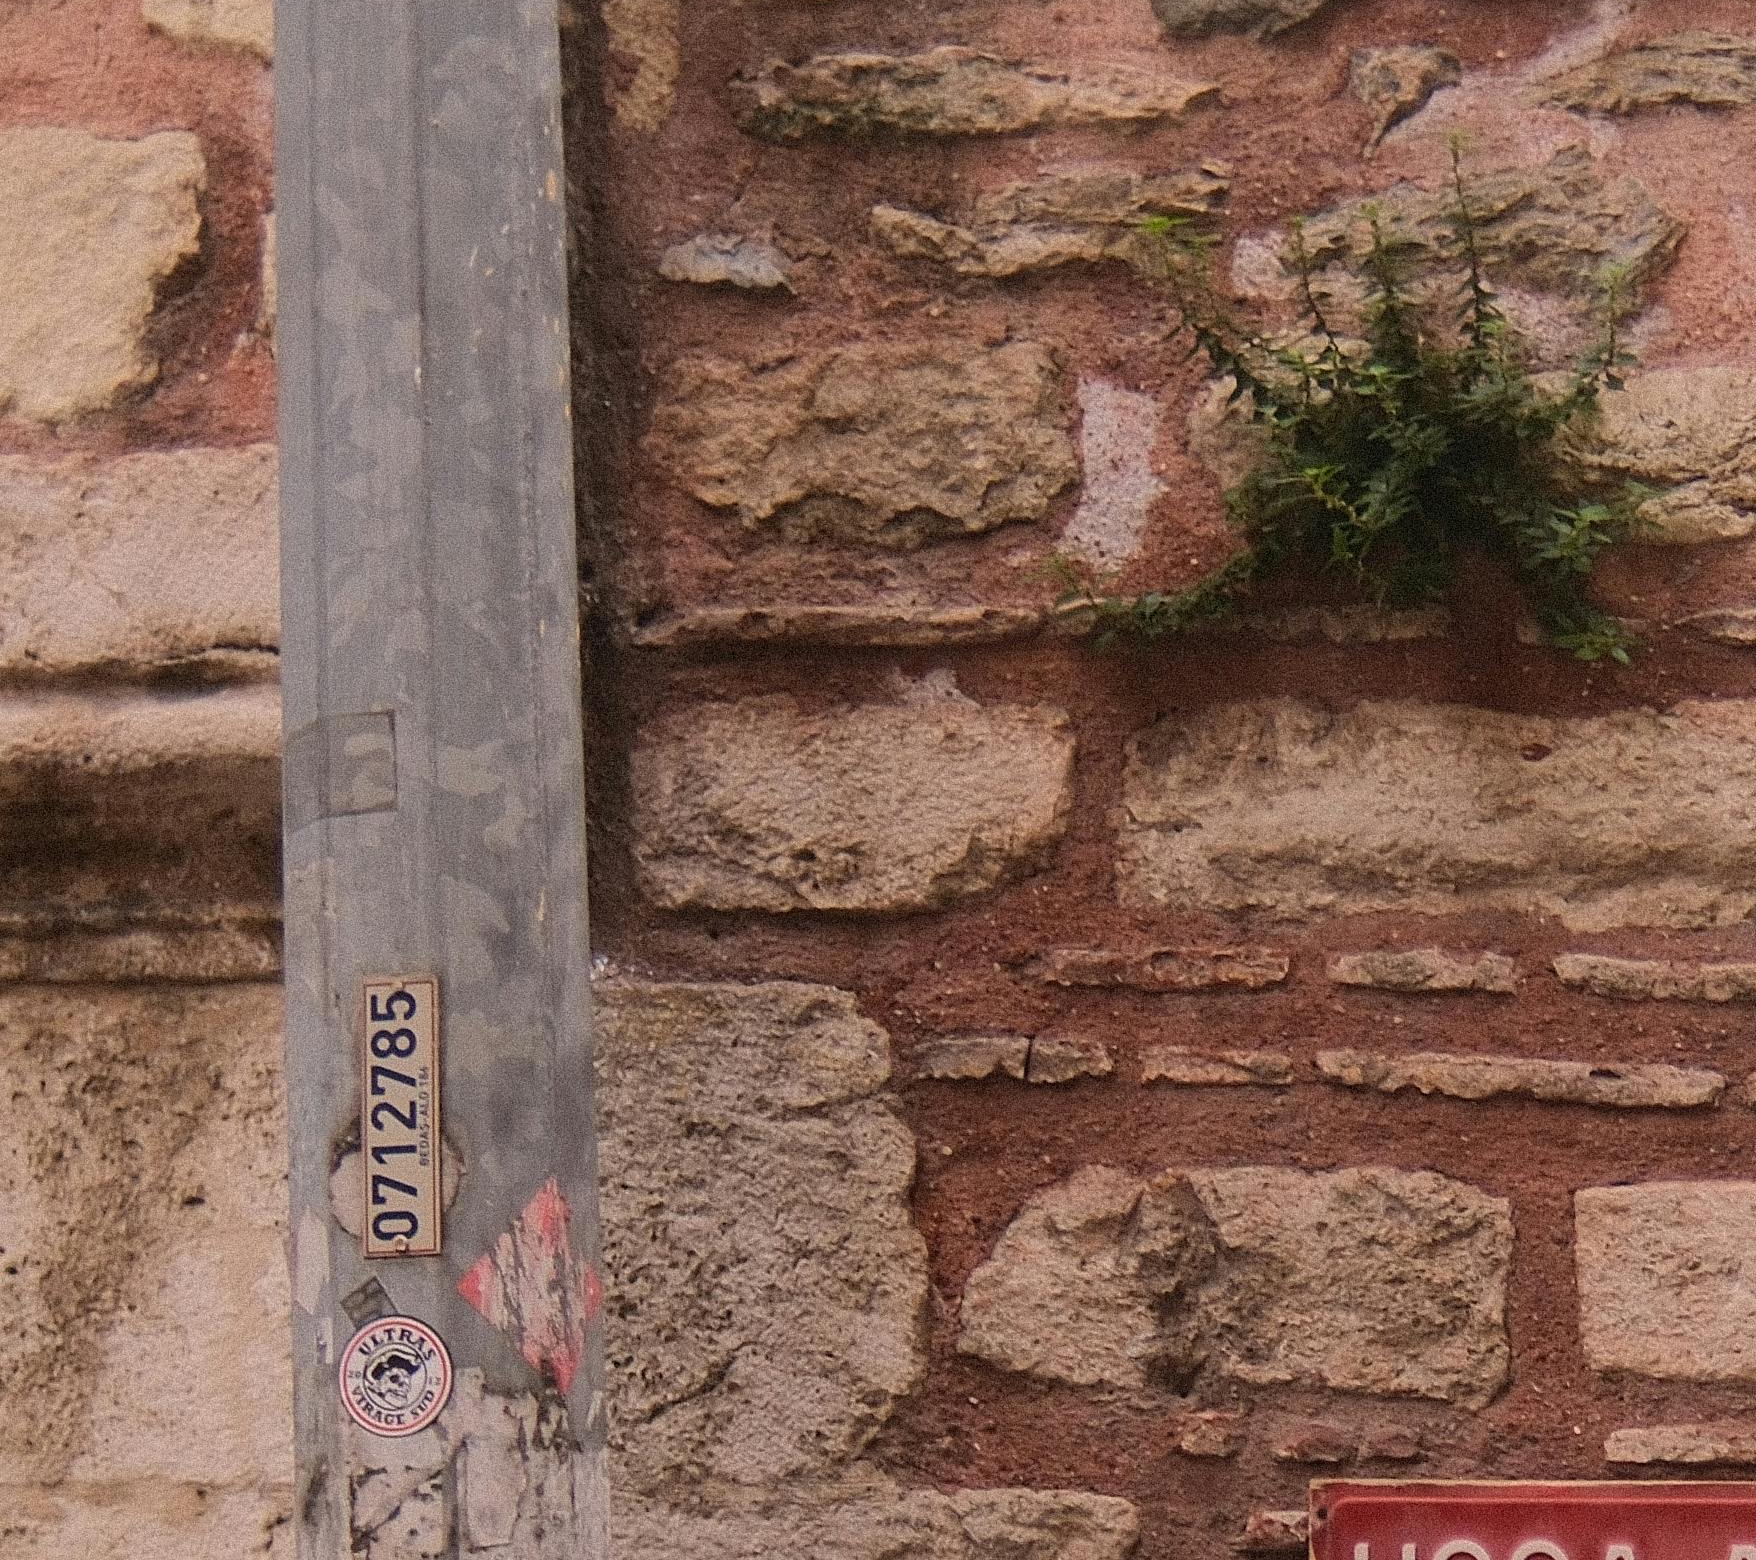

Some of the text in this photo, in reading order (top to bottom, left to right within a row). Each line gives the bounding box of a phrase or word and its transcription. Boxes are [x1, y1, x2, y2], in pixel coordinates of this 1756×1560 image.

[370, 989, 418, 1242] 0712785
[358, 1328, 437, 1361] ULTRAS
[351, 1385, 435, 1425] VIRAGE SUD
